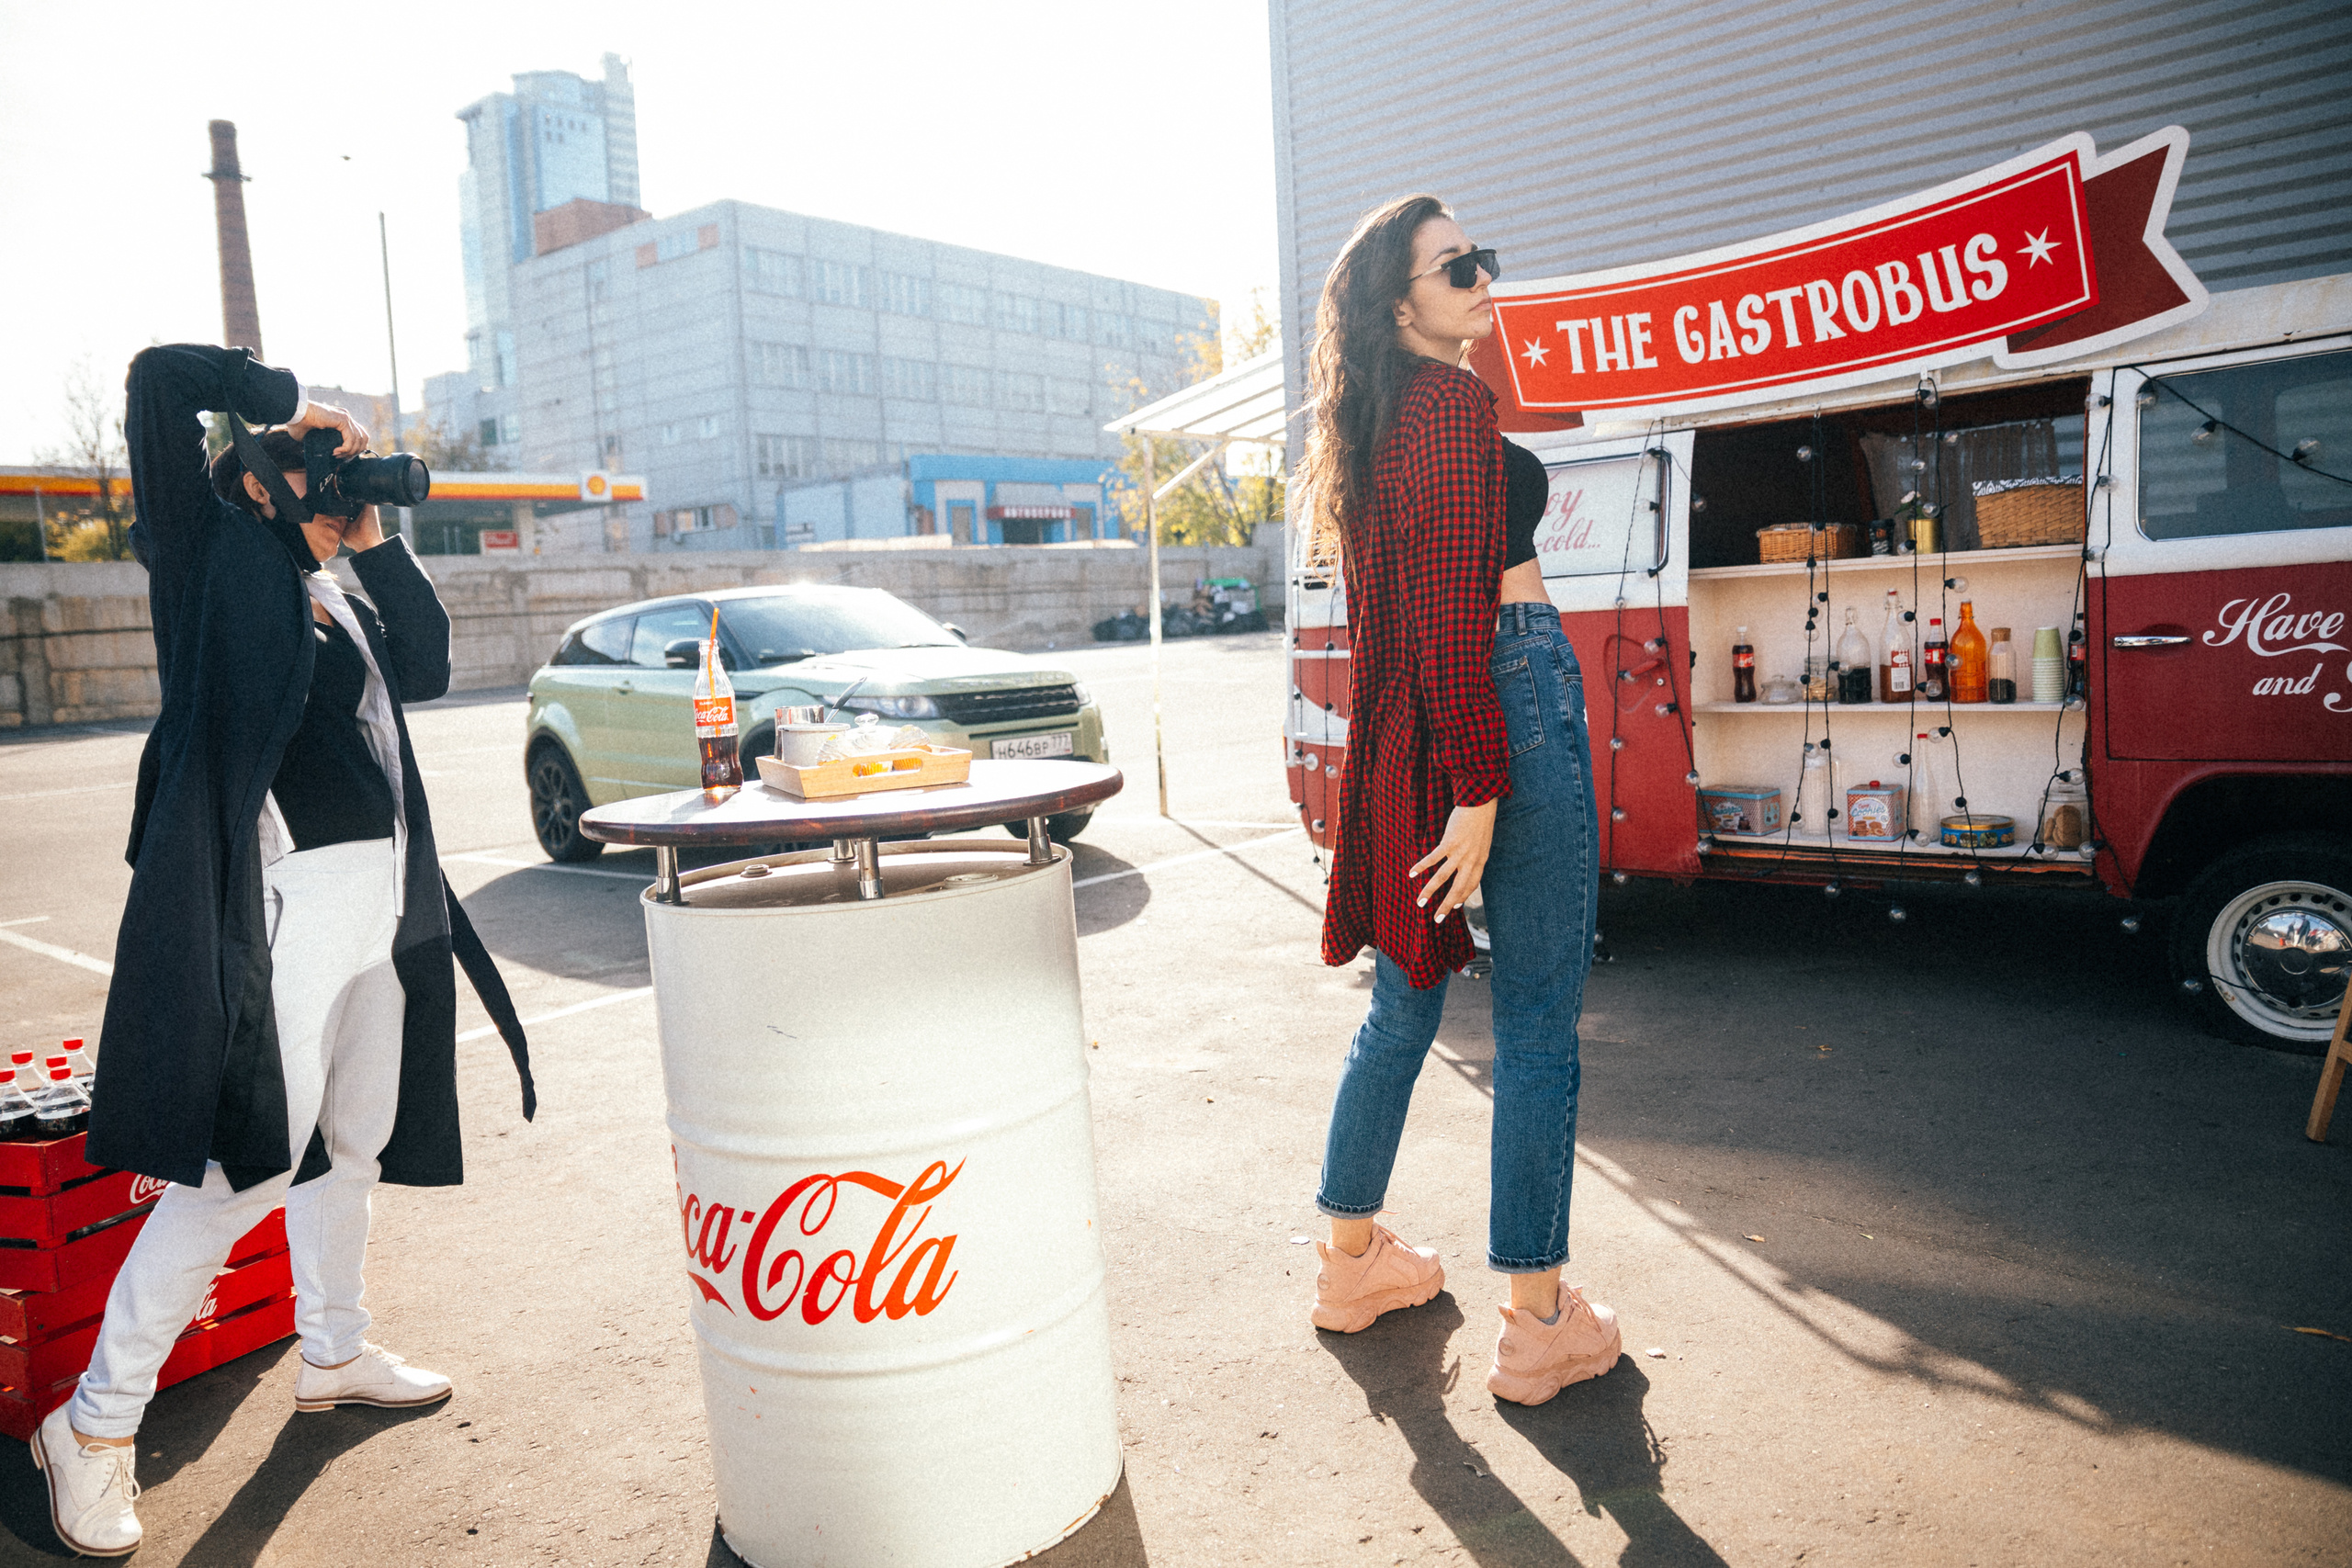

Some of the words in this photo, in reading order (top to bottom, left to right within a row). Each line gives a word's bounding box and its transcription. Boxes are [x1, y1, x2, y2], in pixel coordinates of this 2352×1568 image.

[1555, 312, 1658, 375] THE
[1673, 233, 2009, 365] GASTROBUS
[2202, 592, 2351, 657] Have
[2252, 662, 2324, 696] and
